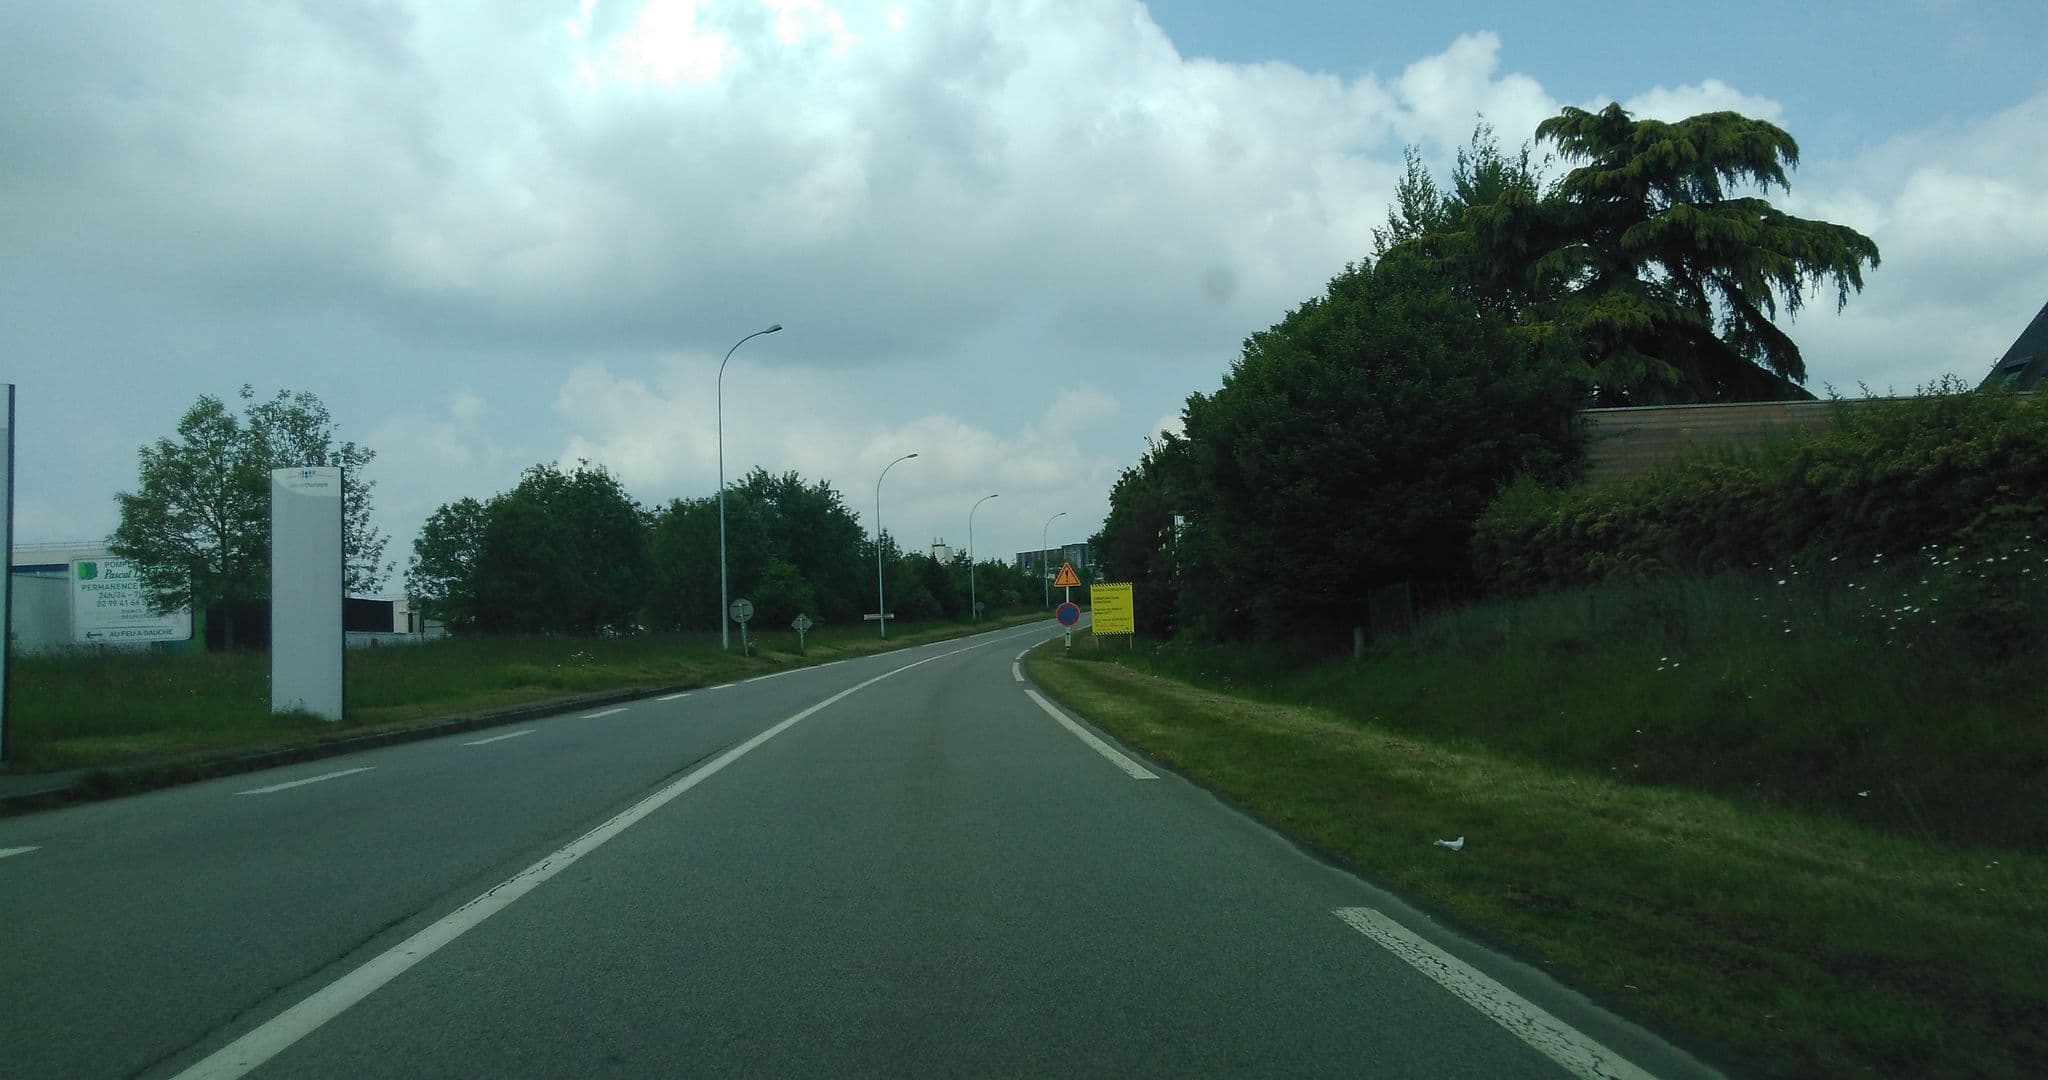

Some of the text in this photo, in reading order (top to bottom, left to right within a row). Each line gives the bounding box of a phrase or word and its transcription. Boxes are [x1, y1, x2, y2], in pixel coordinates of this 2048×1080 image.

[104, 569, 132, 579] Pascal
[82, 582, 138, 591] PERMANENCE
[143, 628, 173, 636] GAUCHE
